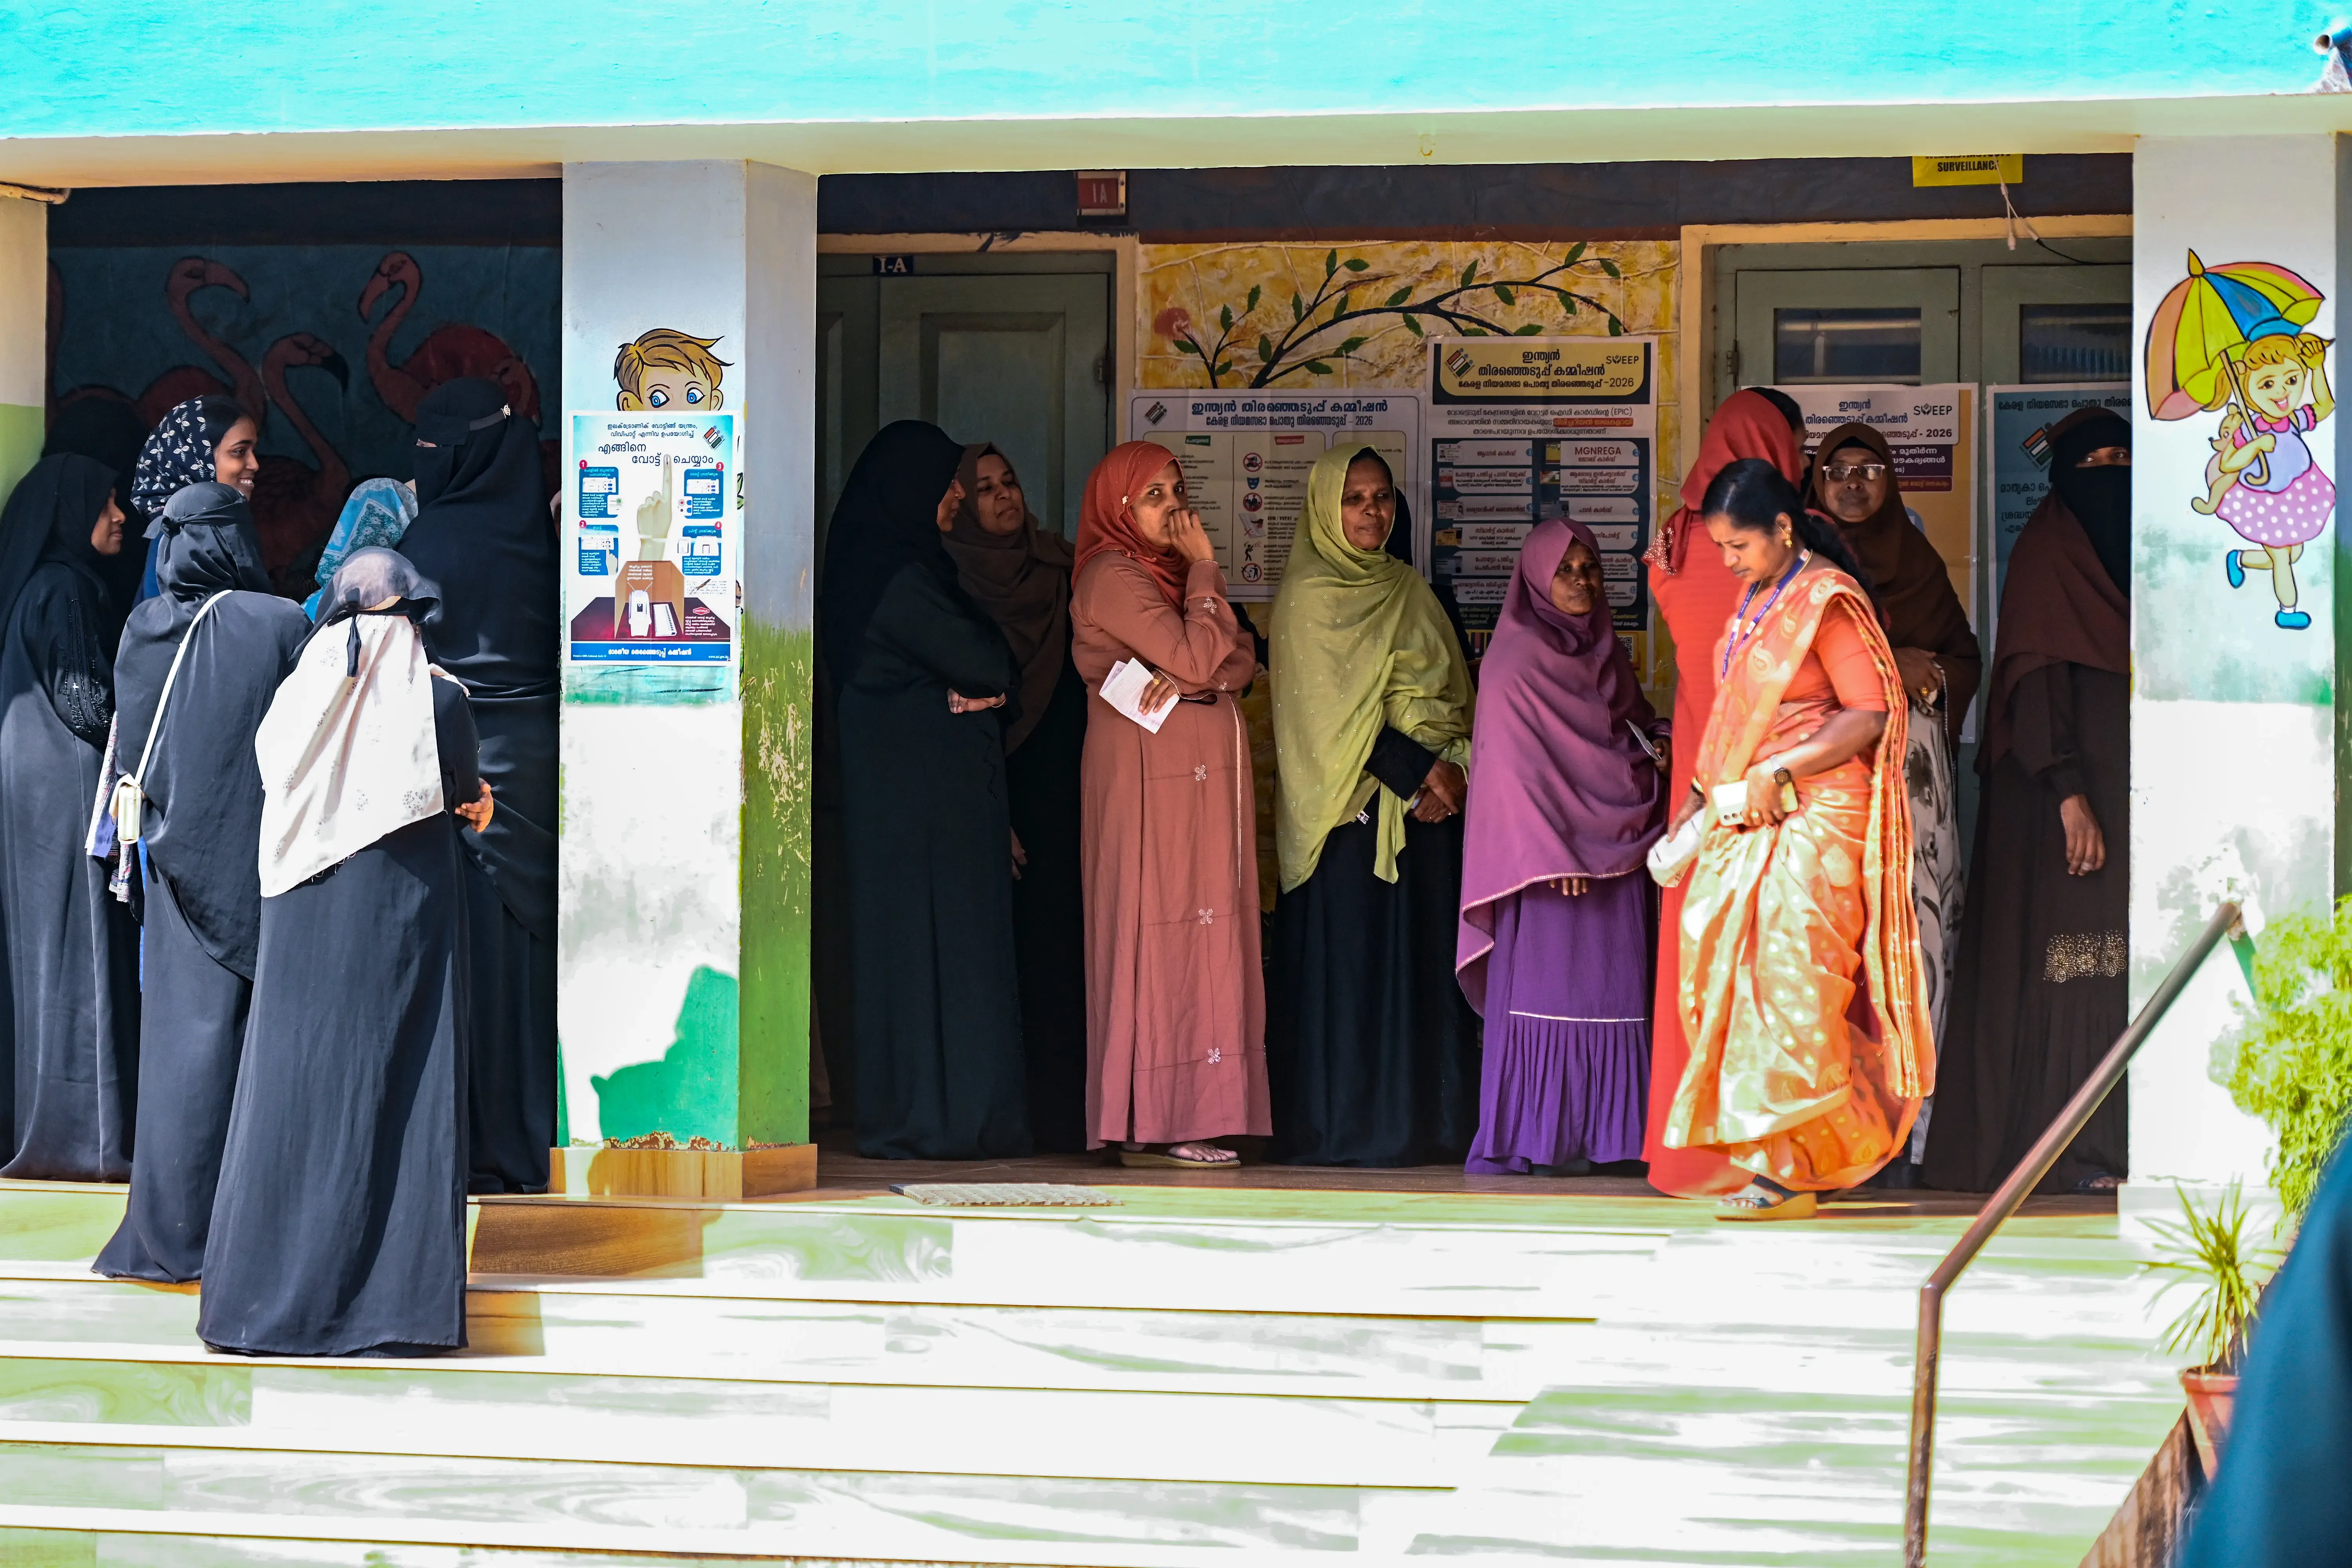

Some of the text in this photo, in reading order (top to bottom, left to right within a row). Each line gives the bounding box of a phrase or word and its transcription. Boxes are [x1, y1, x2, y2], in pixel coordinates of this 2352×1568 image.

[1522, 349, 1561, 363] ഇന്ത്യൻ
[1478, 363, 1605, 378] തിരഞ്ഞെടുപ്പ് കമ്മീഷൻ
[1458, 380, 1481, 389] കേരള
[1483, 379, 1521, 388] നിയമസഭാ
[1523, 380, 1549, 389] പൊതു
[1192, 399, 1388, 416] ഇന്ത്യൻ തിരഞ്ഞെടുപ്പ് കമ്മീഷൻ
[1839, 399, 1871, 412] ഇന്ത്യൻ
[1998, 401, 2024, 411] കേരള
[1611, 407, 1632, 416] (EPIC)
[1206, 416, 1229, 427] കേരള
[1230, 416, 1267, 426] നിയമസഭാ
[1269, 416, 1295, 427] പൊതു
[1297, 415, 1347, 427] തിരഞ്ഞെടുപ്പ്
[1356, 416, 1373, 426] 2026
[1866, 413, 1908, 423] കമ്മീഷൻ
[611, 430, 636, 439] വിവിപാറ്റ്
[661, 430, 694, 438] ഉപയോഗിച്ച്
[1926, 429, 1952, 437] 2026
[598, 441, 646, 454] എങ്ങിനെ
[1575, 446, 1621, 455] MGNREGA
[1899, 447, 1937, 456] മുതിർന്ന
[632, 452, 713, 467] വോട്ട് ചെയ്യാം
